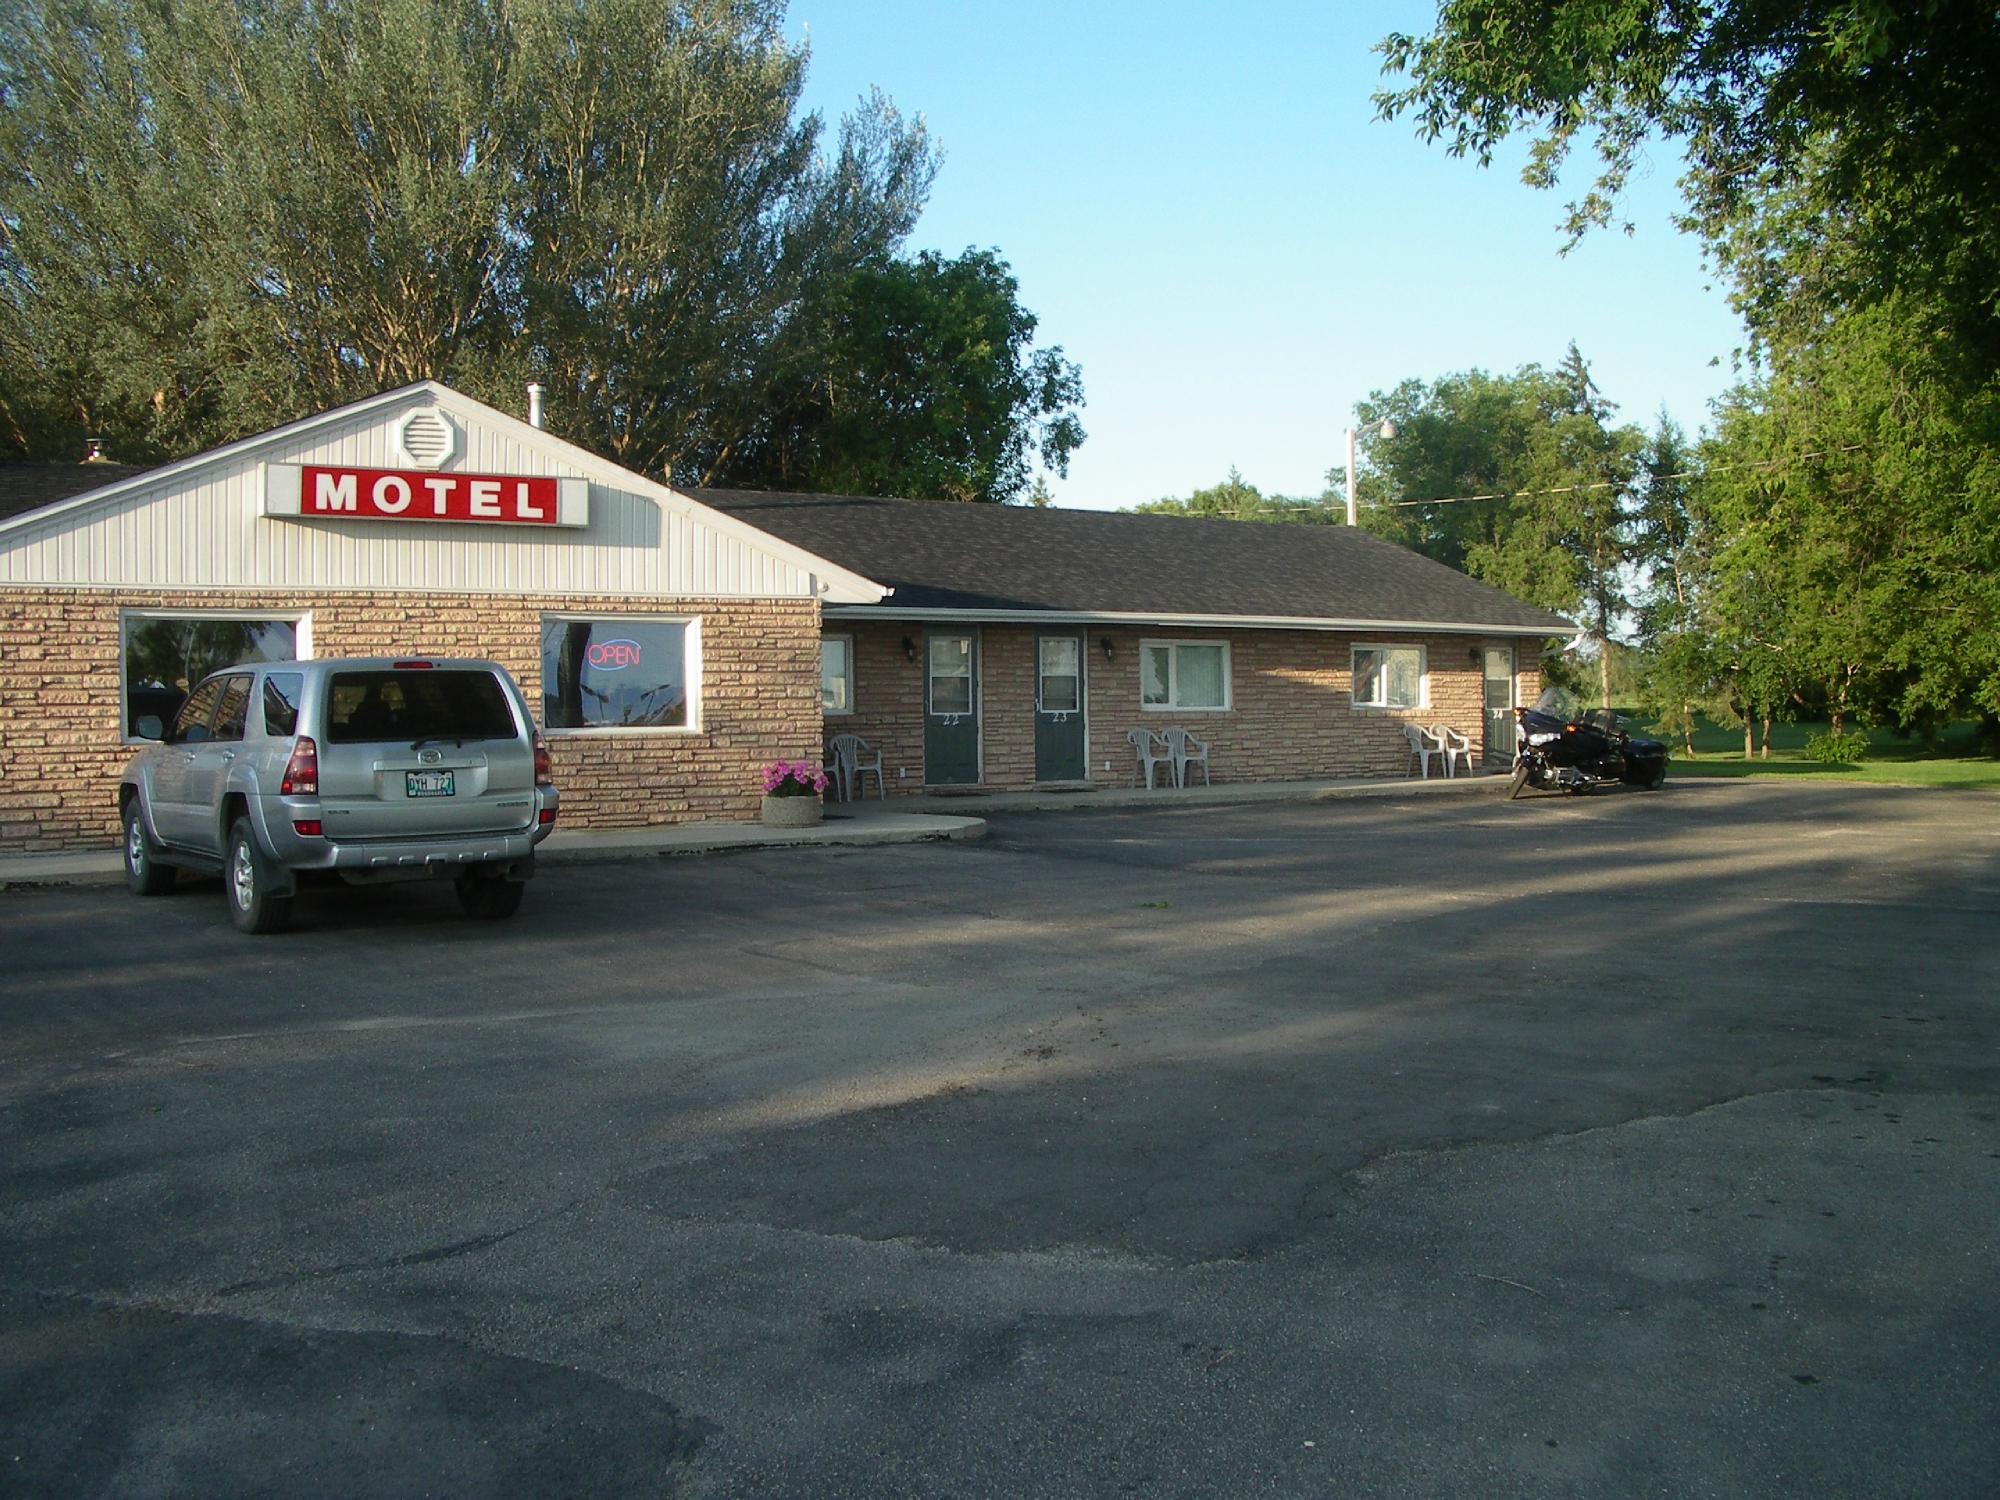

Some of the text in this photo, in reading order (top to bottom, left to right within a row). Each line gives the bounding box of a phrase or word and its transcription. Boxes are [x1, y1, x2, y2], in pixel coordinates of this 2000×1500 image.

[315, 473, 544, 519] MOTEL
[588, 644, 641, 665] OPEN
[943, 713, 960, 725] 22
[1052, 711, 1068, 722] 23
